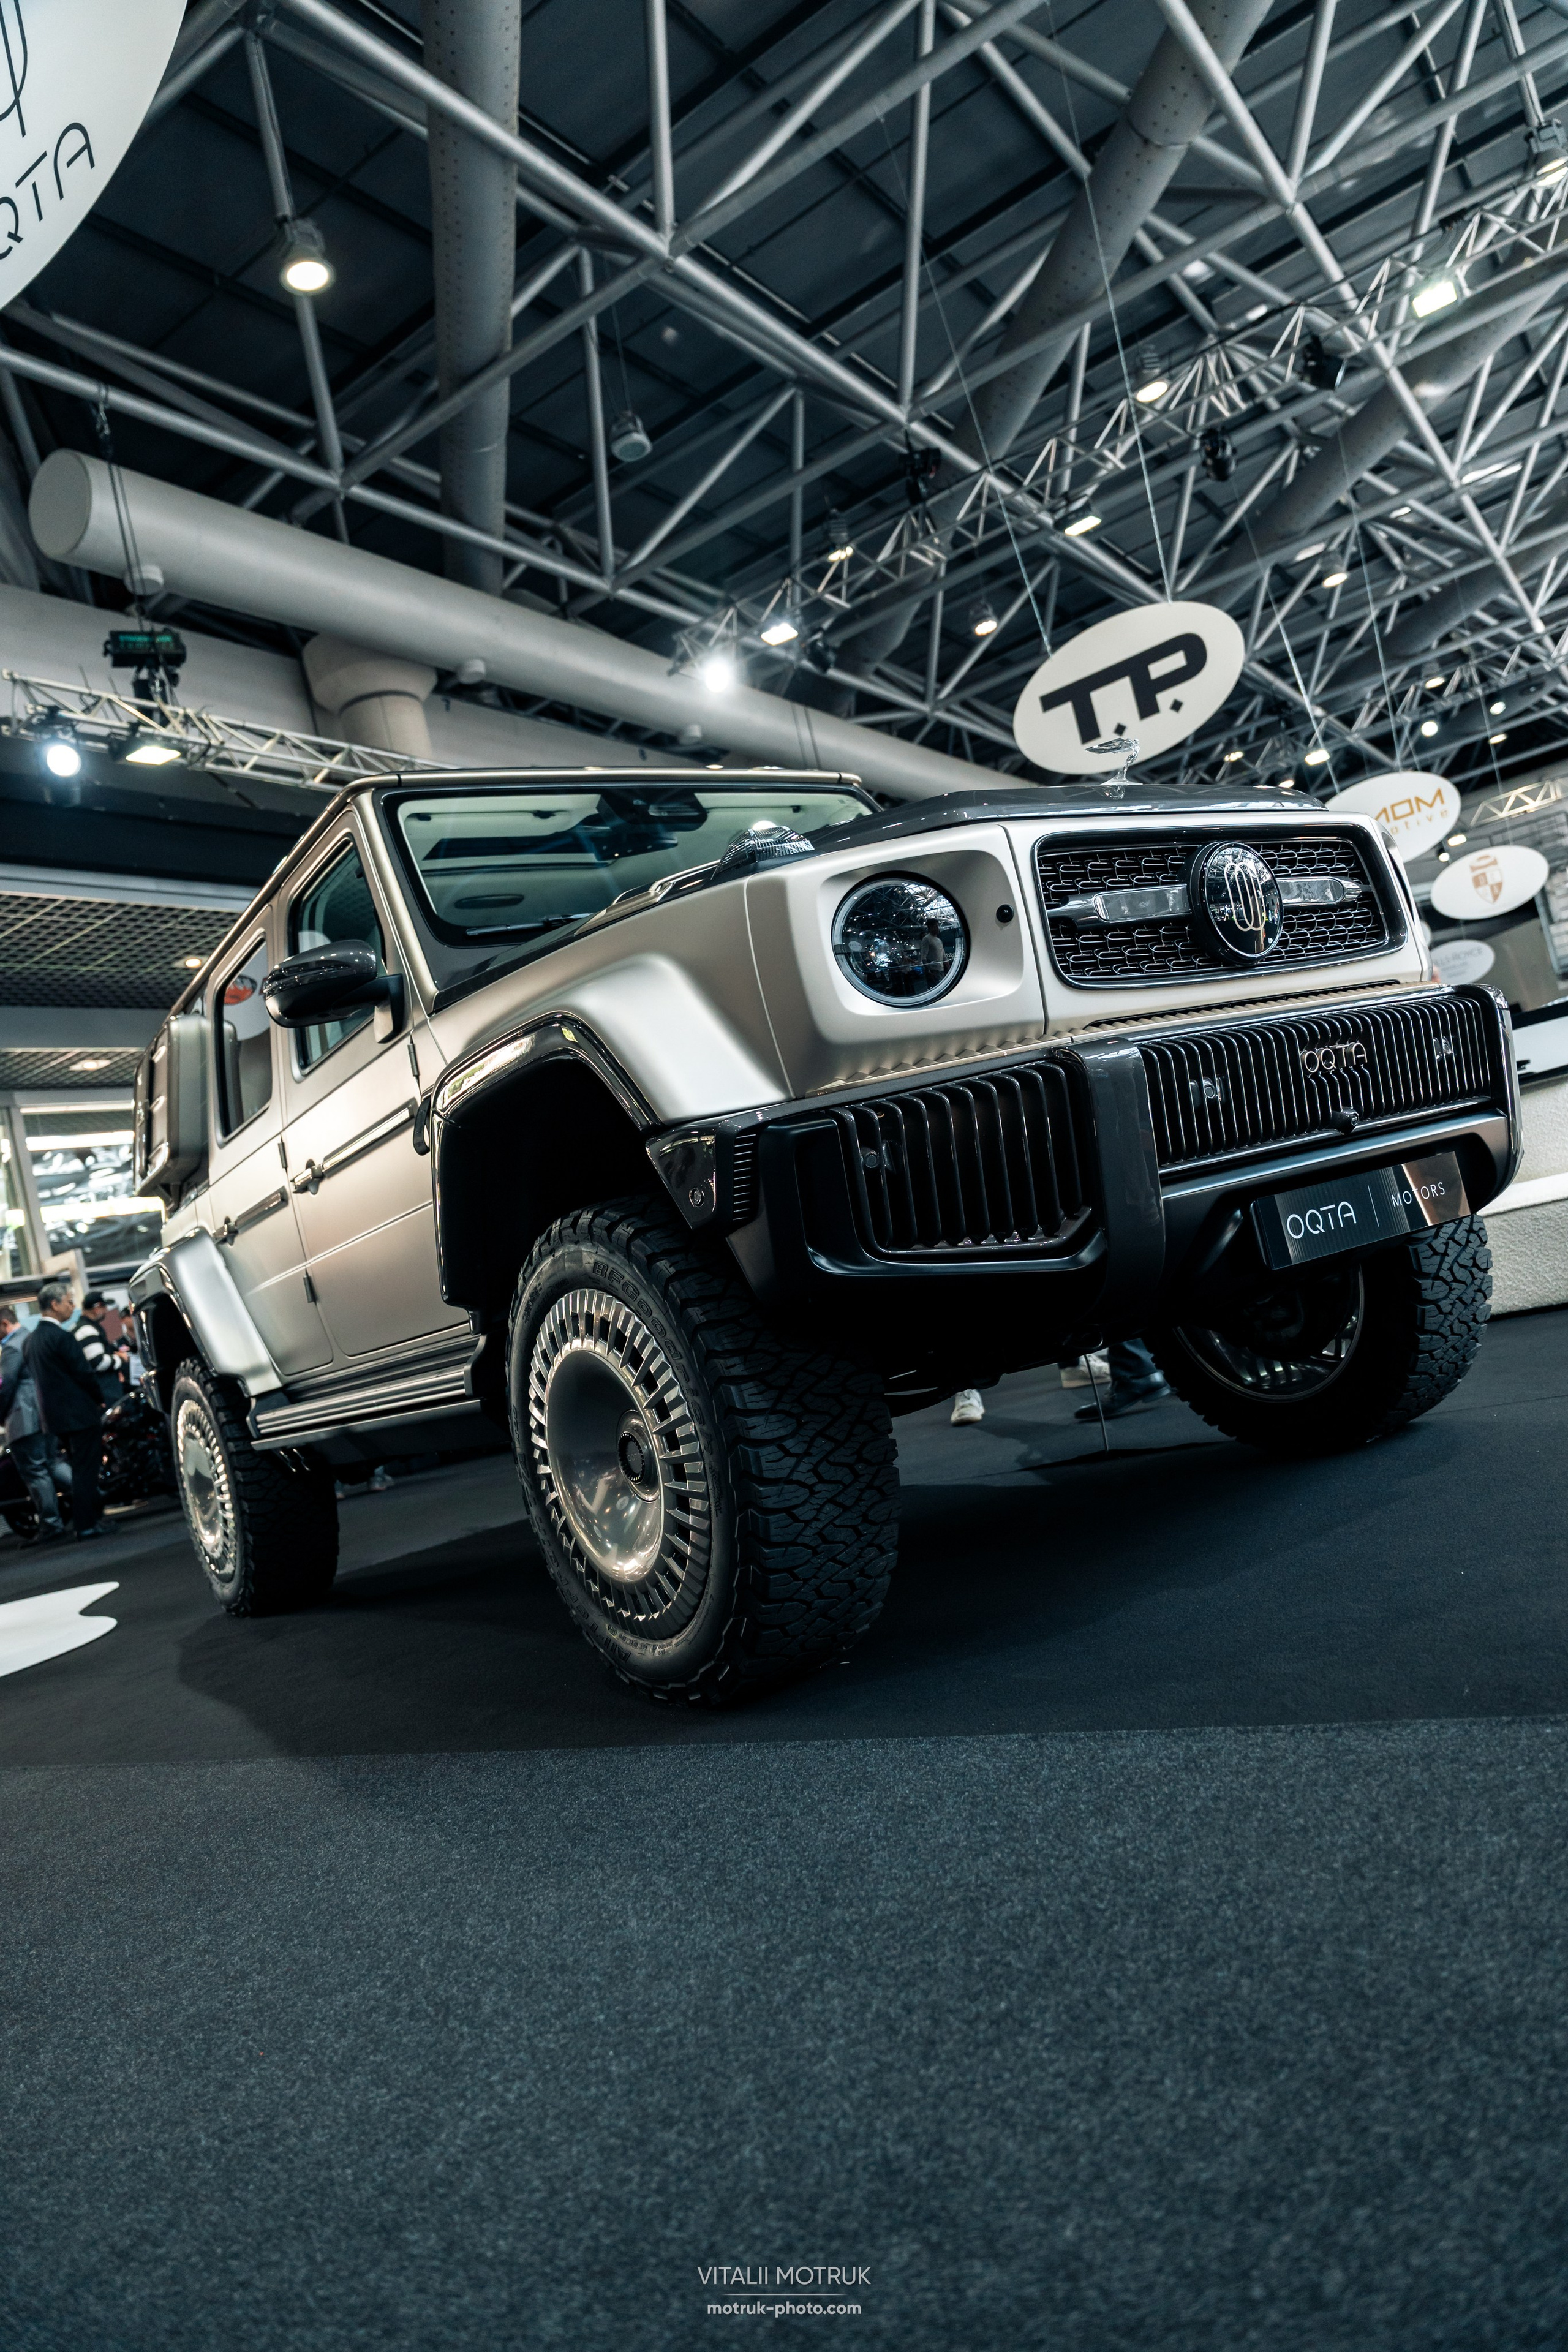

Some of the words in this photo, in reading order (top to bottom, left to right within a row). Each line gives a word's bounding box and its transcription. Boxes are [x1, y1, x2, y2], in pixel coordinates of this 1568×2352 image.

[1300, 1042, 1368, 1074] OQTA
[1287, 1201, 1357, 1239] OQTA
[1391, 1182, 1446, 1208] MOTORS
